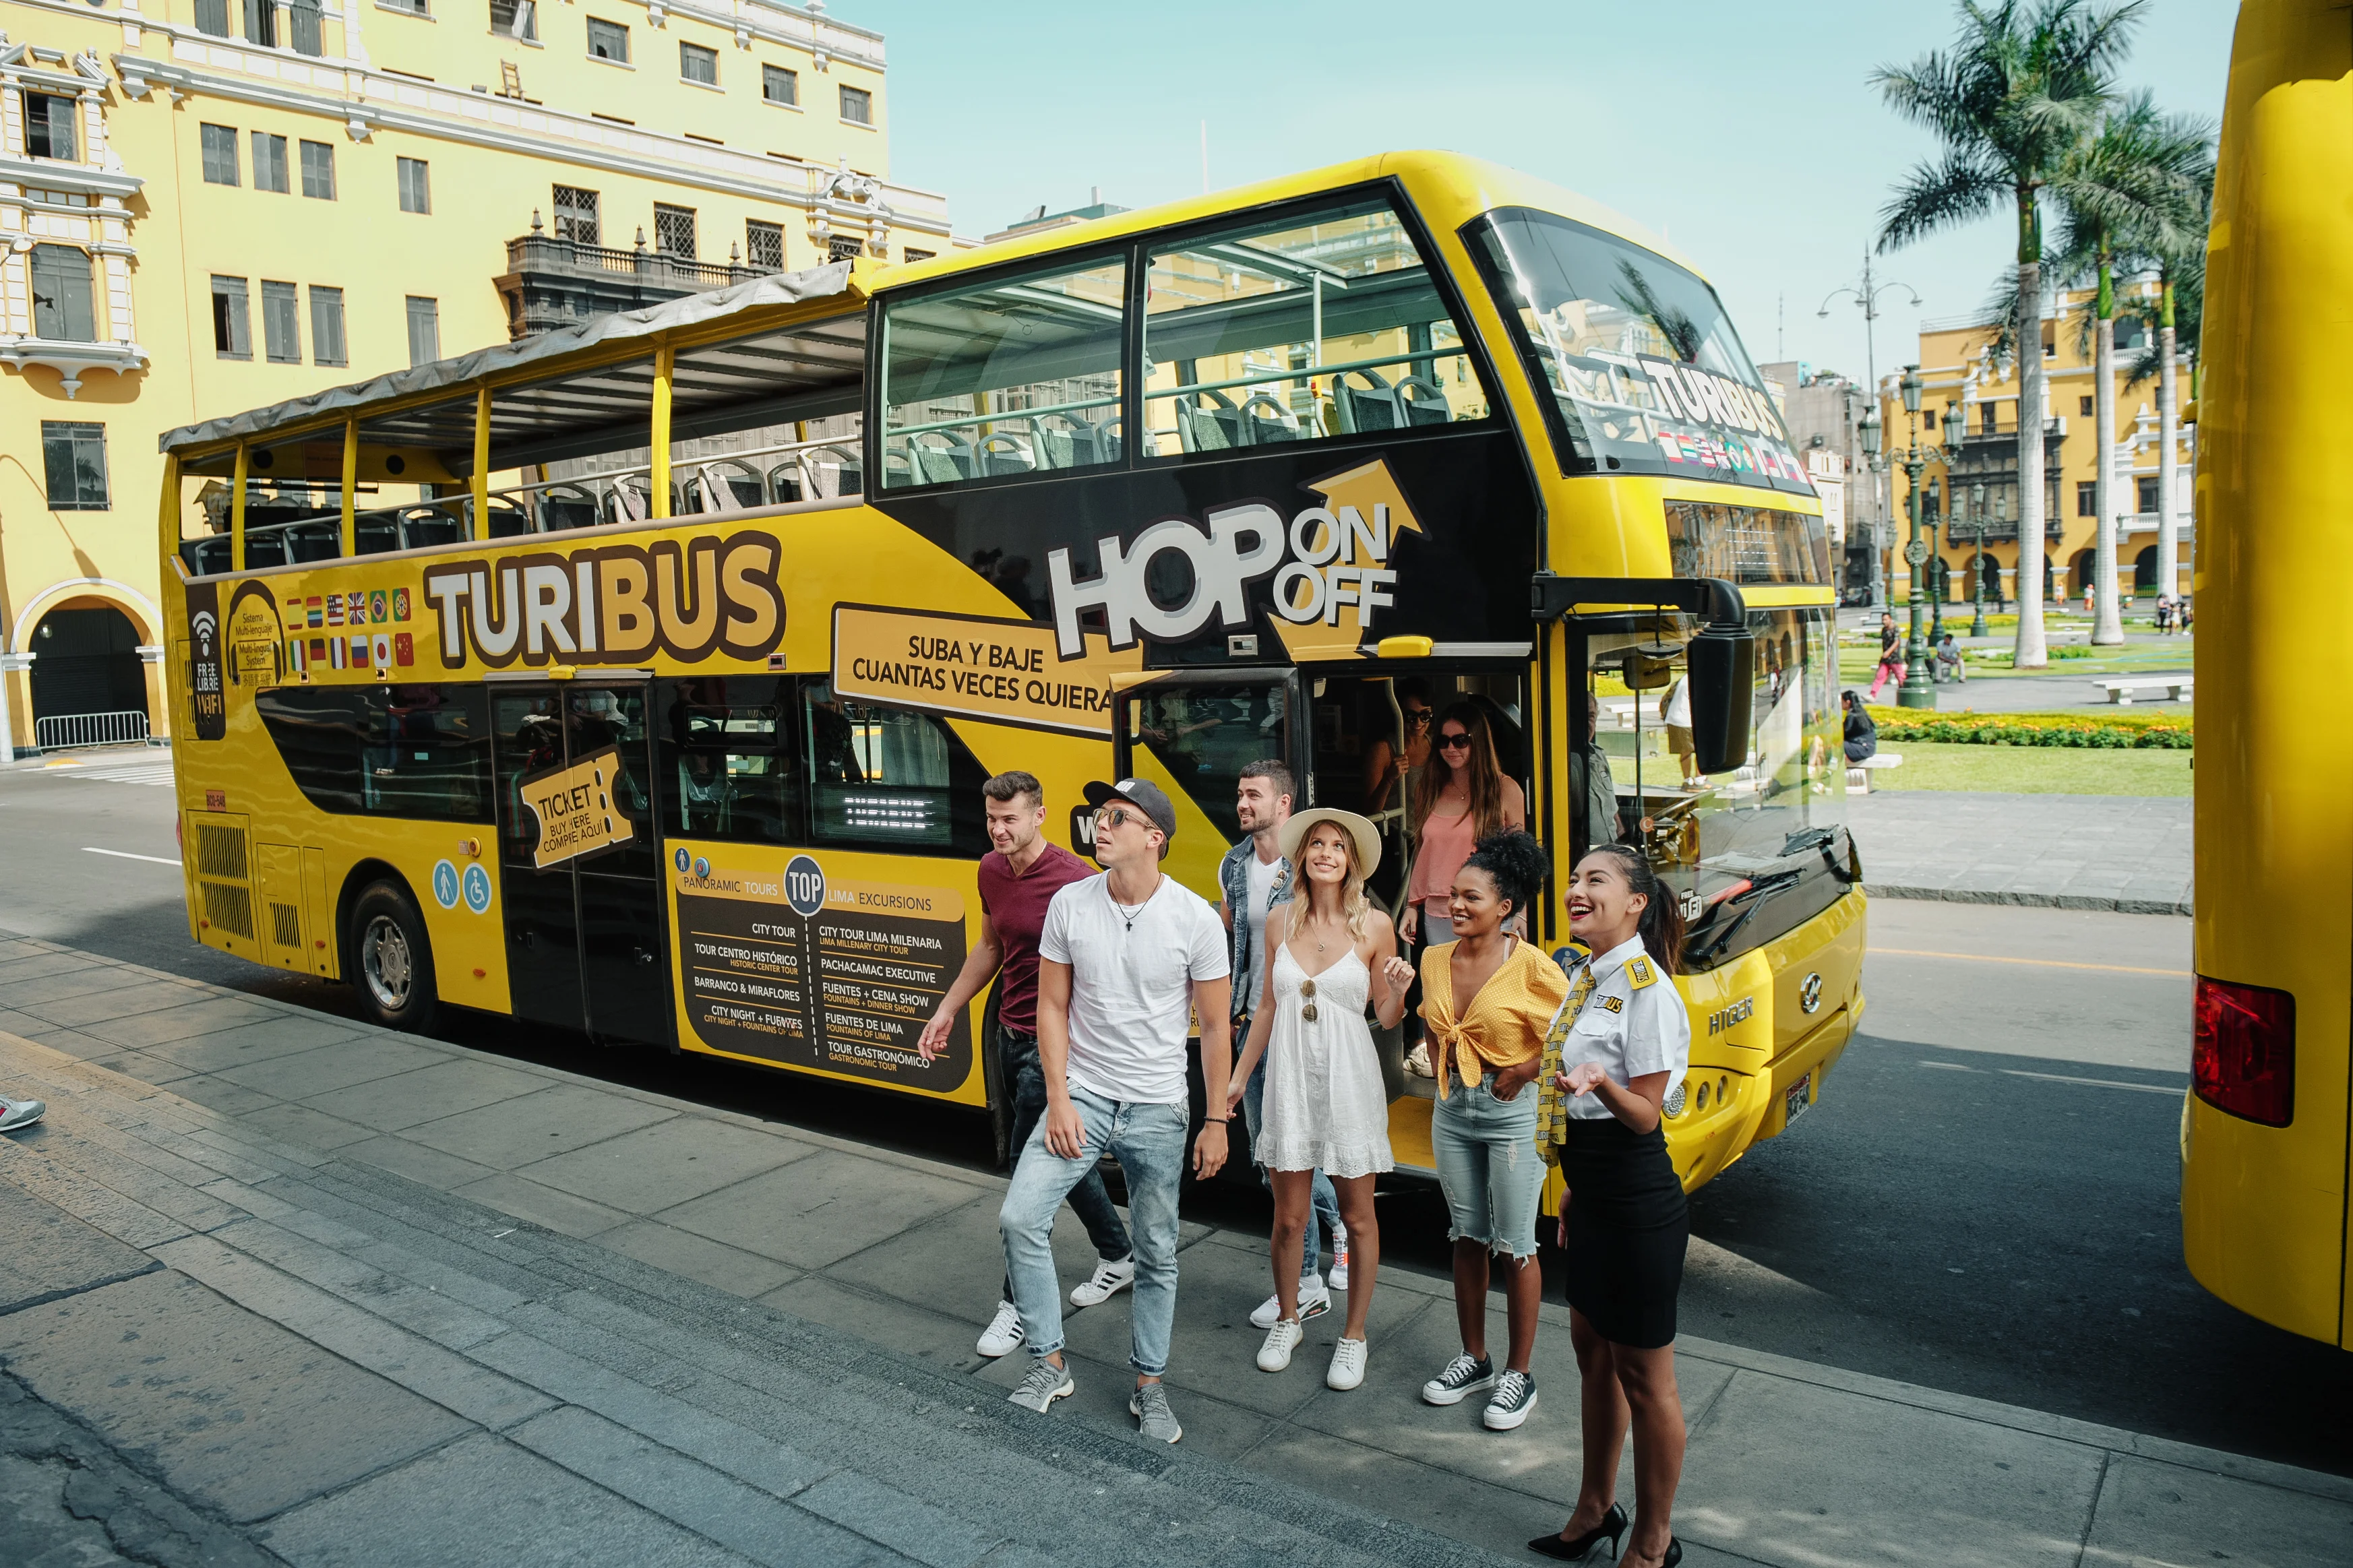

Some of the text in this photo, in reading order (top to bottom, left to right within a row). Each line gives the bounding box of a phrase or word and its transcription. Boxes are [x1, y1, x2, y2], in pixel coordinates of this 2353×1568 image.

[1641, 359, 1785, 442] TURIBUS
[1048, 502, 1388, 657] HOP ON
[429, 544, 778, 658] TURIBUS
[1273, 561, 1397, 627] OFF
[235, 623, 272, 637] Multi-lenguaje
[243, 613, 264, 624] Sistema
[239, 641, 272, 656] Multi-lingual
[908, 635, 1044, 673] SUBA Y BAJE
[197, 663, 216, 677] FREE
[246, 655, 266, 668] System
[197, 677, 219, 691] LIBRE
[853, 656, 1111, 713] CUANTAS VECES QUIERA
[538, 783, 591, 821] TICKET
[543, 819, 603, 853] COMPRE AQUÍ
[550, 812, 591, 837] BUY HERE
[684, 876, 778, 897] PANORAMIC TOURS
[789, 871, 822, 903] TOP
[1680, 889, 1694, 900] FREE
[828, 889, 932, 912] LIMA EXCURSIONS
[752, 923, 796, 939] CITY TOUR
[819, 925, 943, 951] CITY TOUR LIMA MILENARIA
[694, 943, 797, 966] TOUR CENTRO HISTÓRICO
[819, 937, 909, 955] LIMA MILLENARY CITY TOUR
[730, 959, 799, 976] HISTORIC CENTER TOUR
[821, 958, 937, 984] PACHACAMAC EXECUTIVE
[694, 976, 801, 1002] BARRANCO & MIRAFLORES
[822, 982, 929, 1008] FUENTES + CENA SHOW
[823, 993, 860, 1007] FOUNTAINS
[867, 999, 893, 1011] DINNER
[894, 1004, 916, 1015] SHOW
[1709, 995, 1754, 1037] HIGER
[704, 1014, 718, 1024] CITY
[718, 1016, 737, 1027] NIGHT
[742, 1021, 777, 1035] FOUNTAINS
[788, 1028, 805, 1039] LIMA
[711, 1005, 803, 1030] CITY NIGHT + FUENTES
[825, 1012, 904, 1035] FUENTES DE LIMA
[826, 1023, 892, 1042] FOUNTAINS OF LIMA
[827, 1041, 931, 1069] TOUR GASTRONÓMICO
[828, 1052, 898, 1072] GASTRONOMIC TOUR
